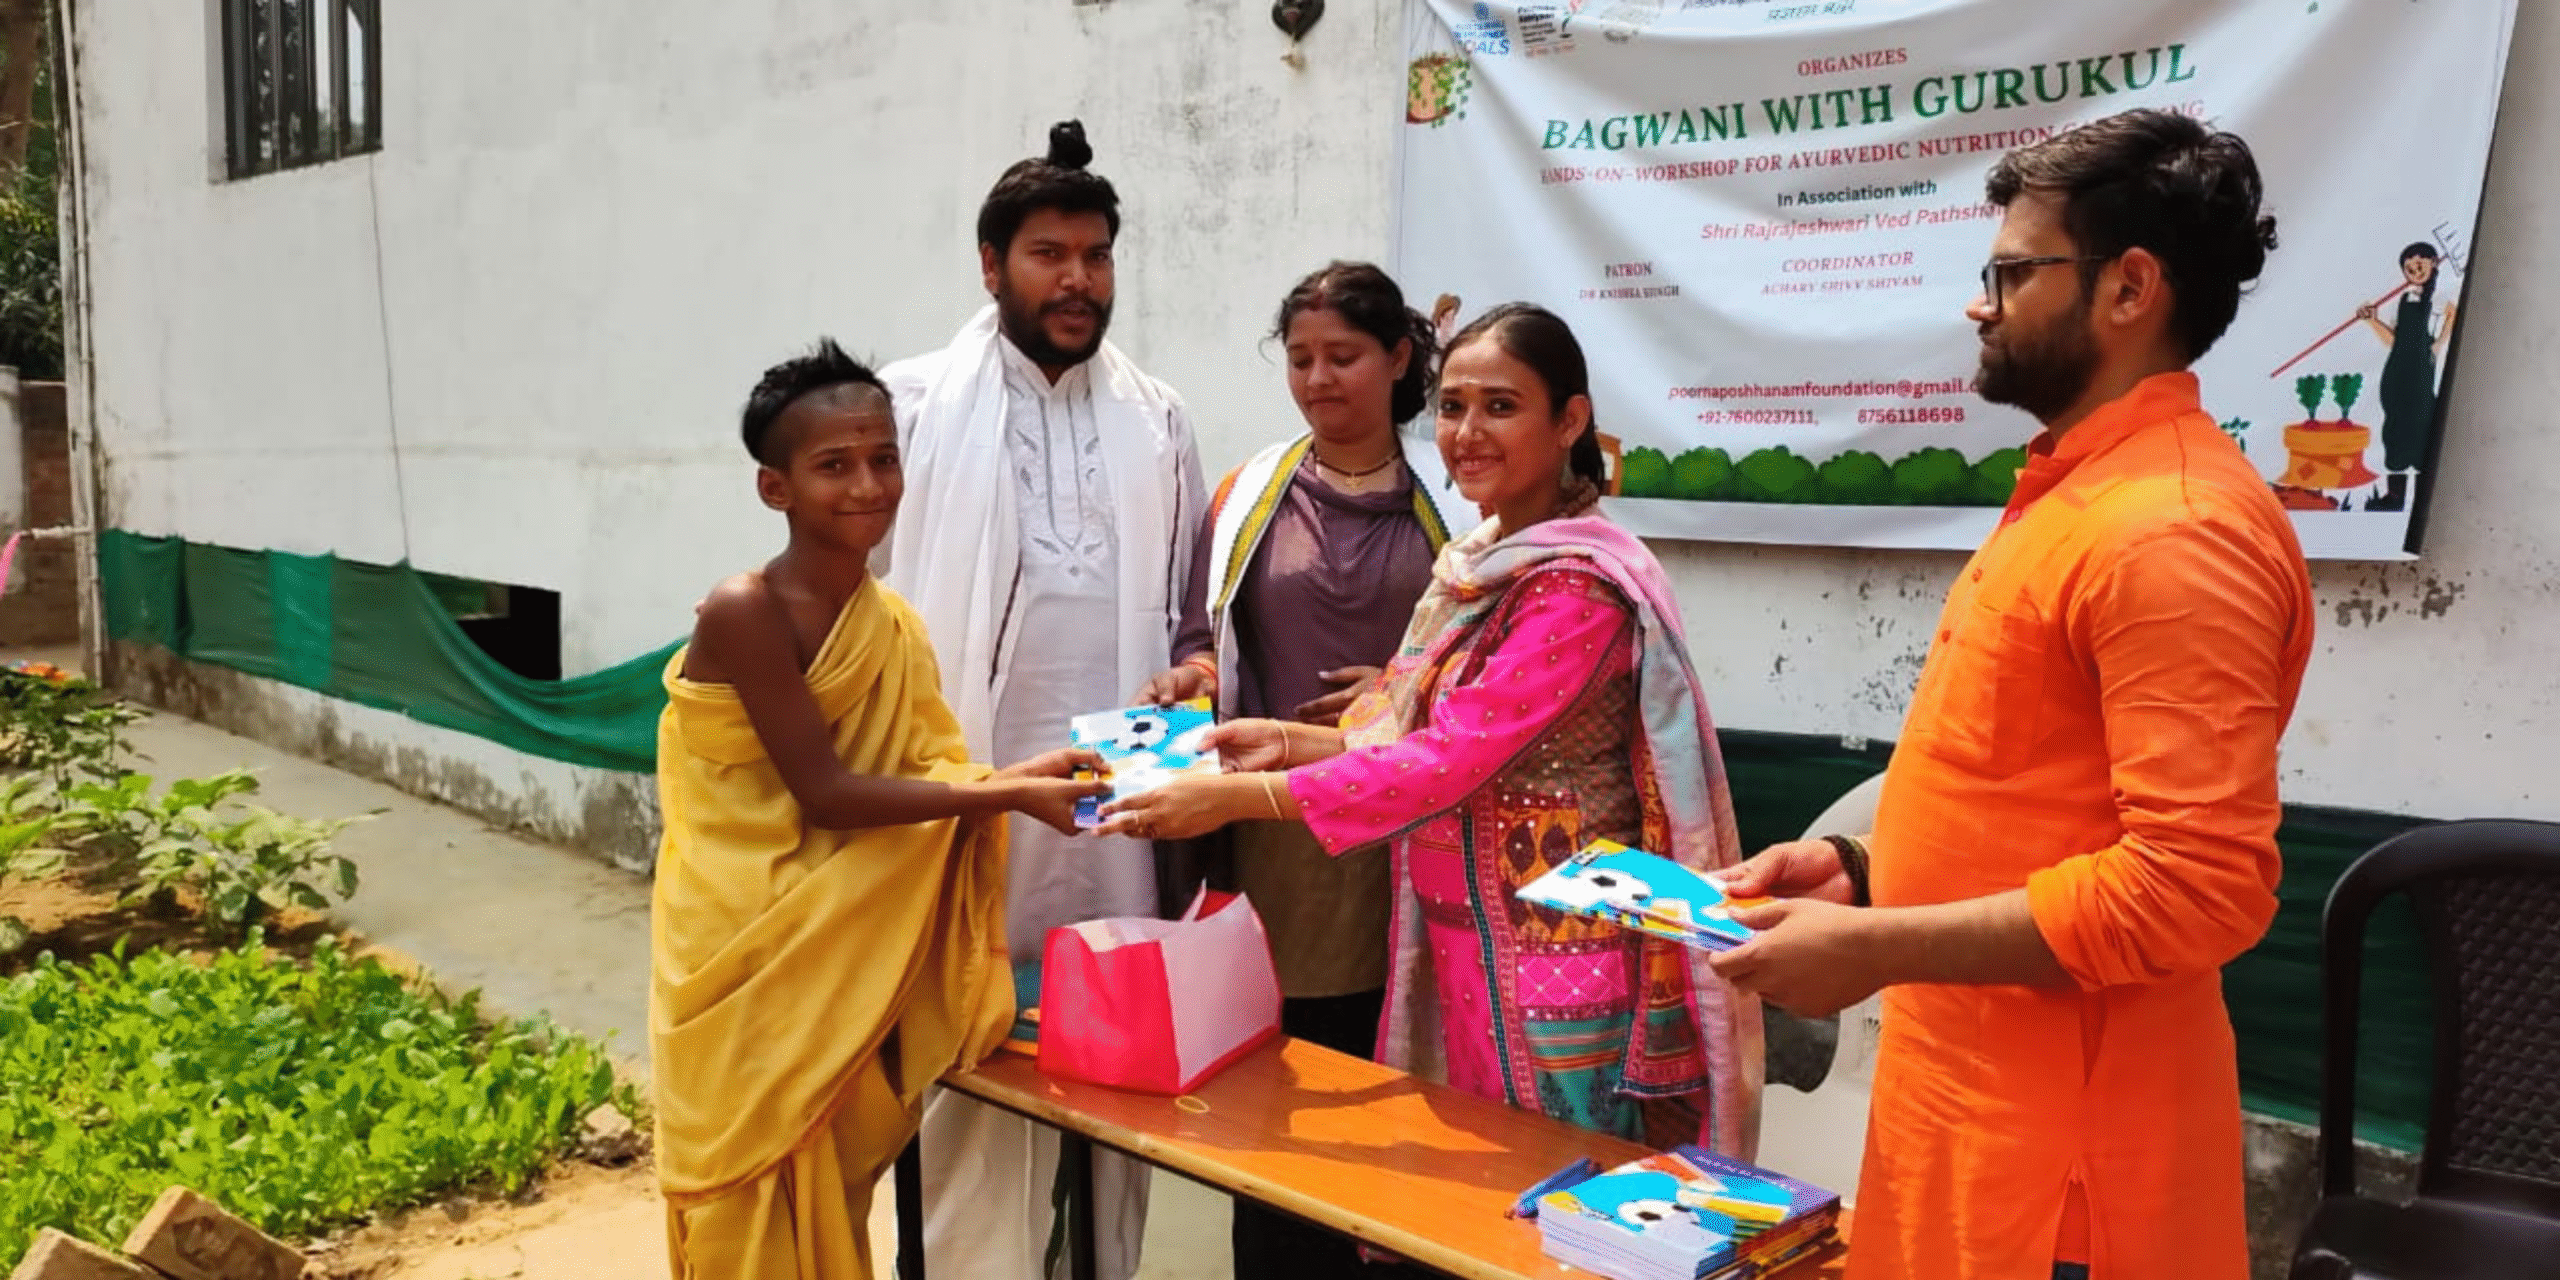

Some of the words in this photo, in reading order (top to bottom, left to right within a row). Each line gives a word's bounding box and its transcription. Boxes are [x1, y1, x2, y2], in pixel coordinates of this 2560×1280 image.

[1797, 47, 1908, 77] ORGANIZES
[1541, 102, 1748, 151] BAGWANI
[1761, 83, 1893, 135] WITH
[1912, 43, 2196, 119] GURUKUL
[1744, 154, 1782, 173] FOR
[1788, 142, 1909, 171] AYURVEDIC
[1918, 125, 2054, 158] NUTRITION
[1777, 192, 1794, 207] In
[1797, 184, 1895, 205] Association
[1898, 179, 1937, 197] with
[1701, 222, 1738, 240] Shri
[1742, 214, 1870, 241] Rajrajeshwari
[1875, 209, 1910, 230] Ved
[1605, 261, 1652, 279] PATRON
[1781, 250, 1914, 274] COORDINATOR
[1857, 406, 1965, 425] 8756118698
